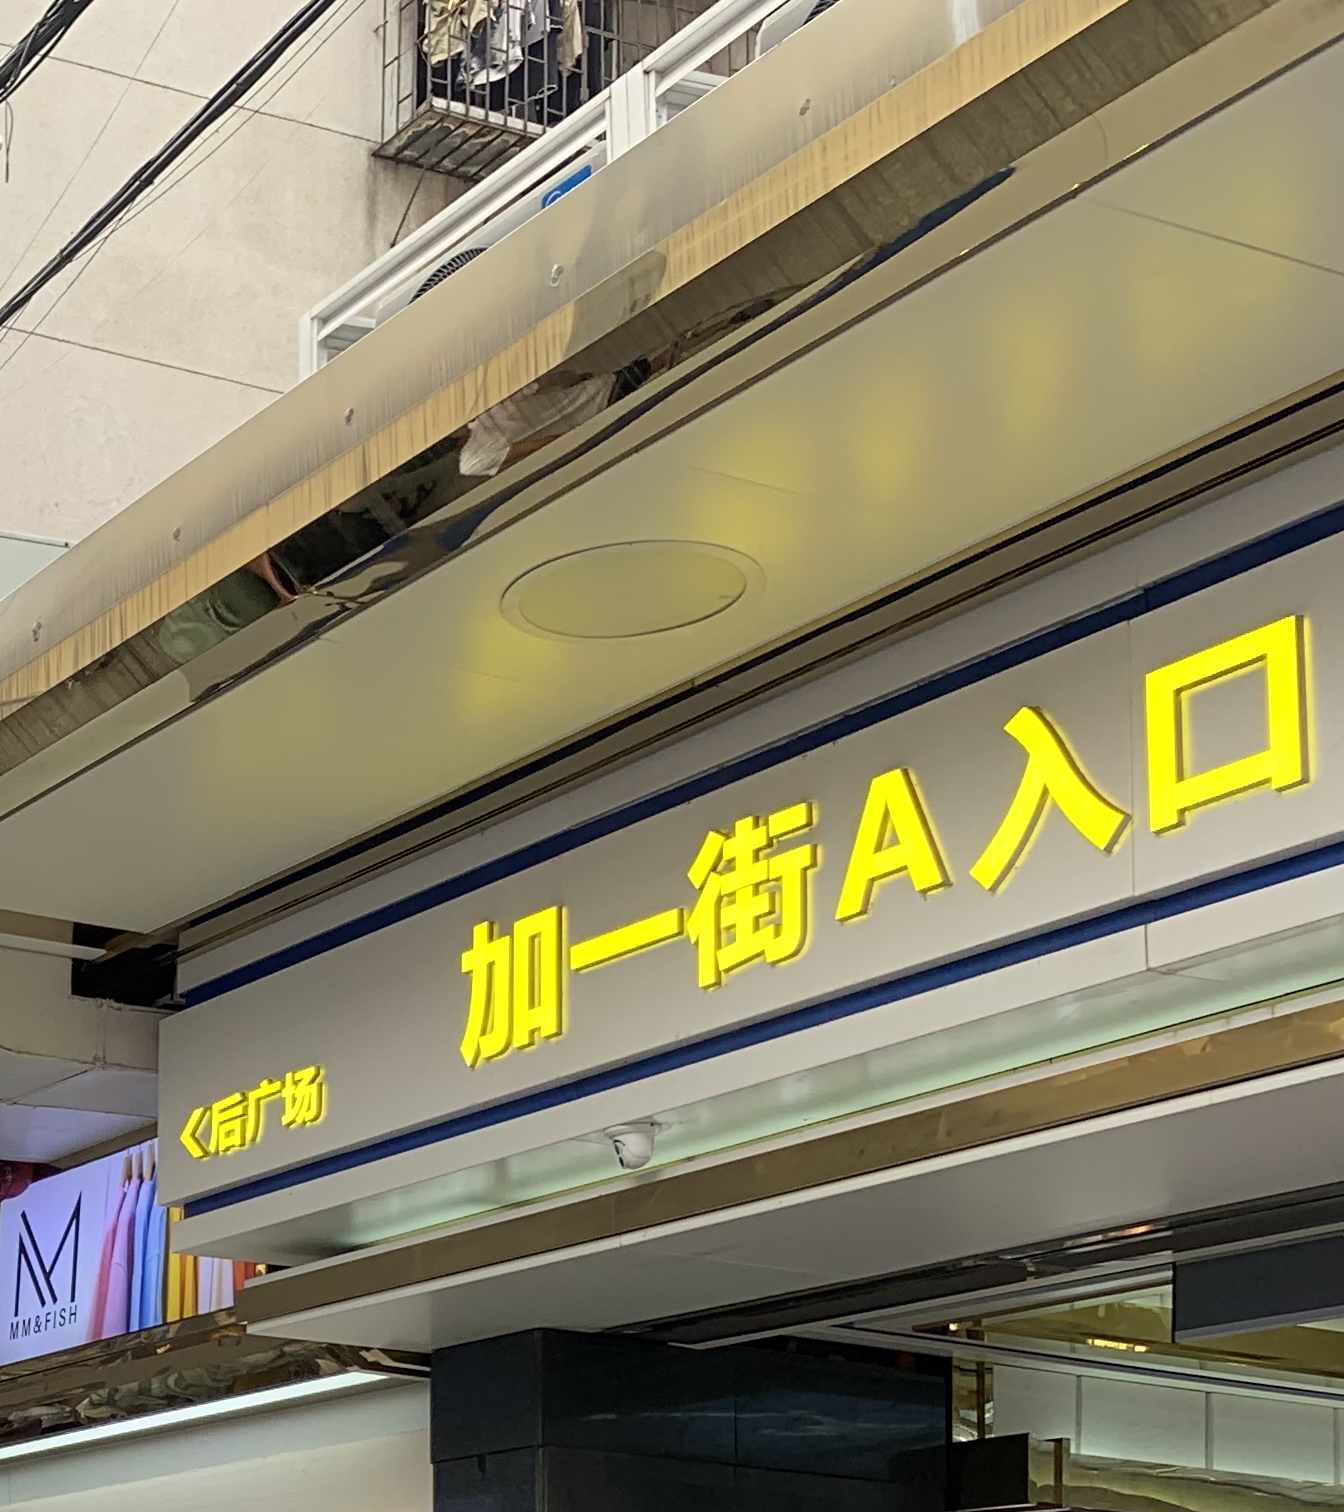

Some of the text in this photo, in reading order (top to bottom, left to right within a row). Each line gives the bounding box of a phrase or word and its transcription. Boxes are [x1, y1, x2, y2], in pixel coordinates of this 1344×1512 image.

[460, 614, 1311, 1067] 加一街A入口
[206, 1064, 327, 1155] 后广场
[8, 1304, 78, 1341] MM&FISH
